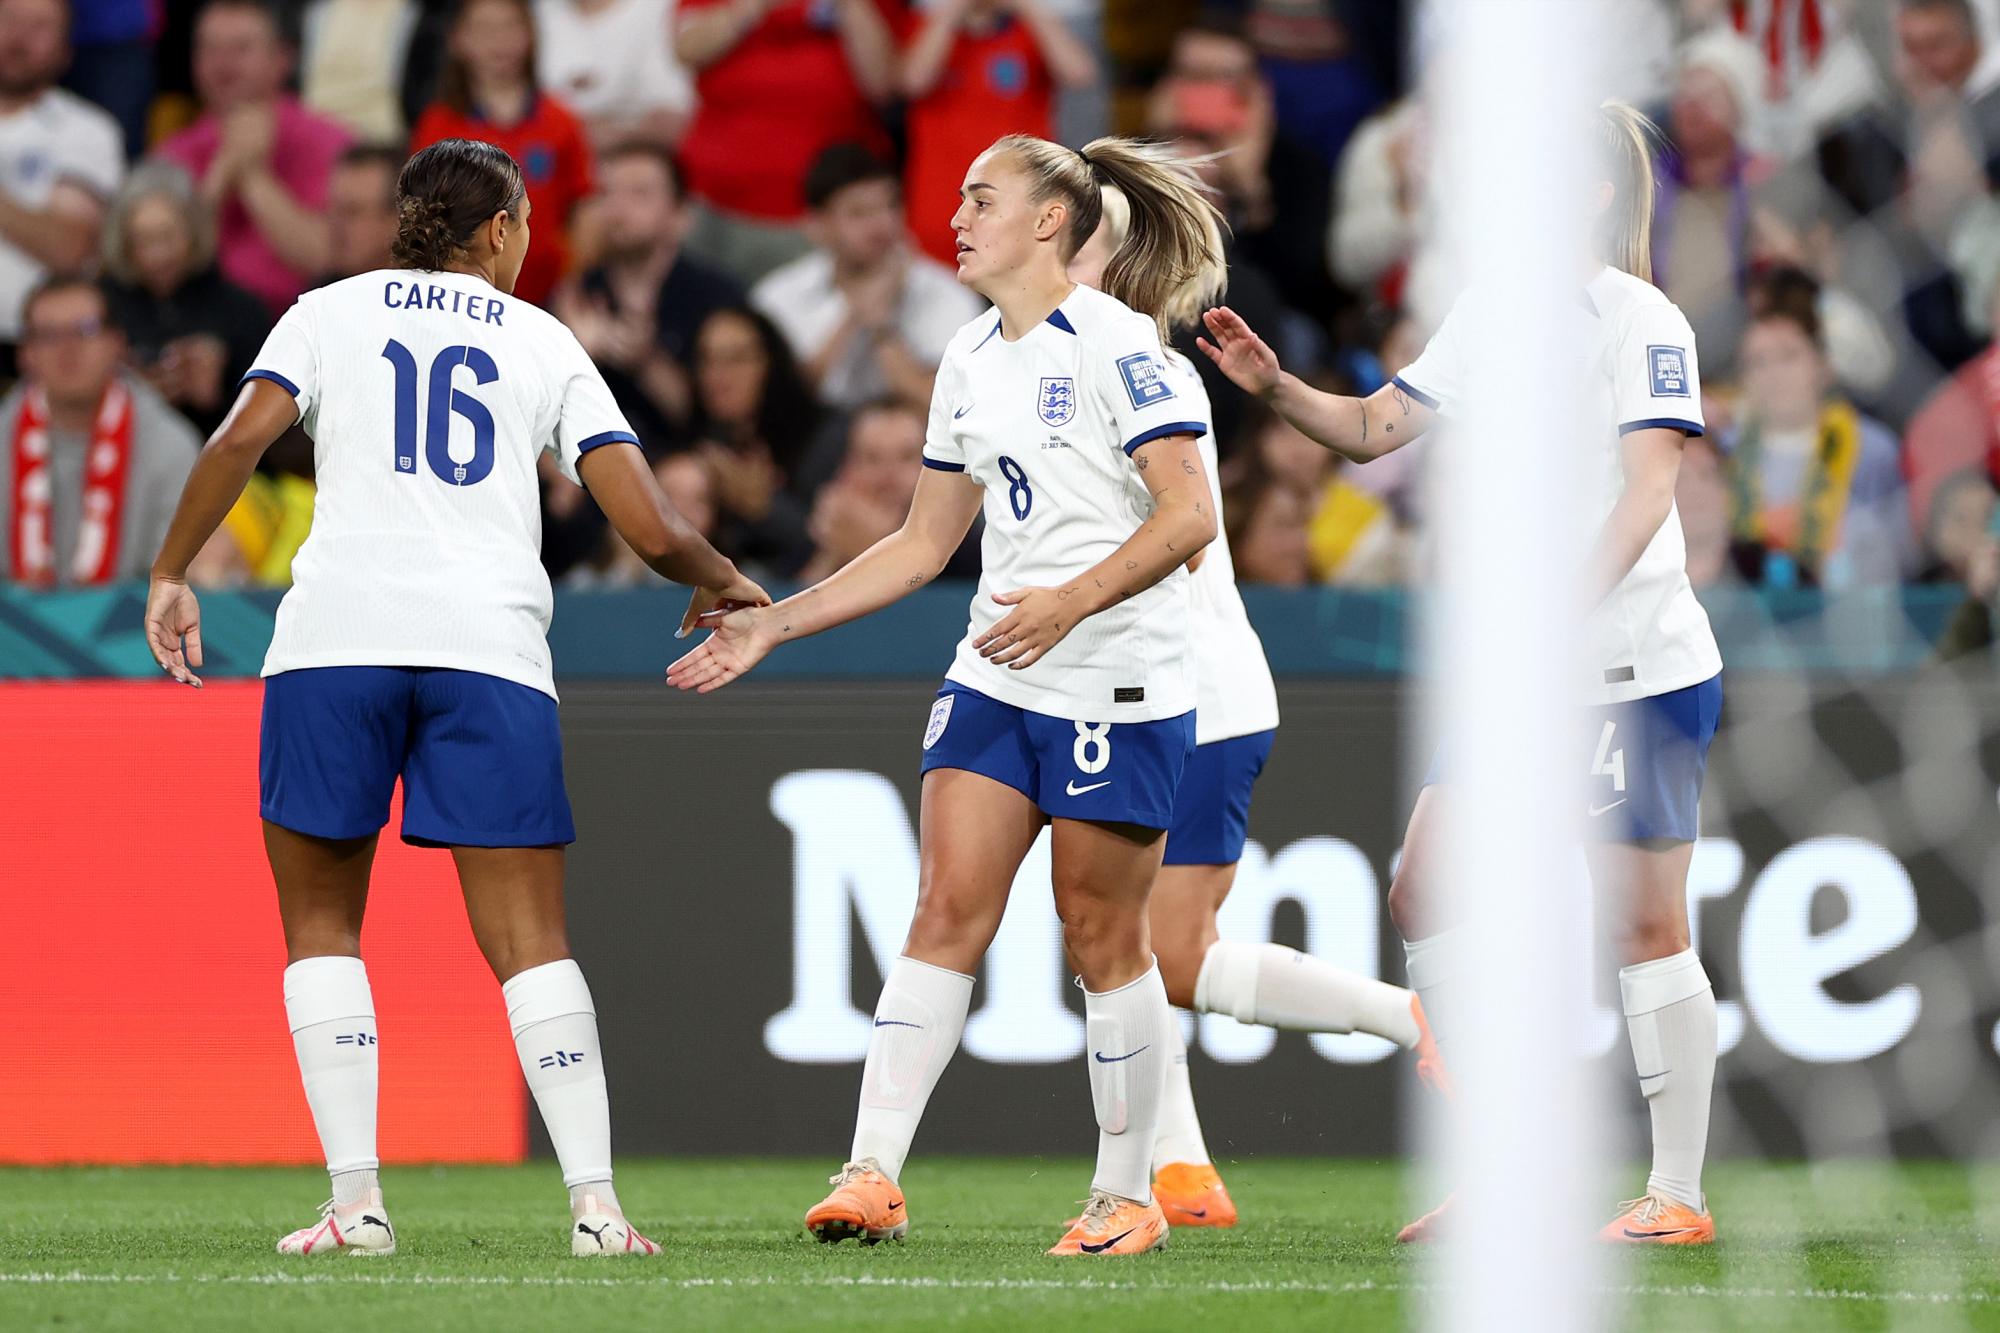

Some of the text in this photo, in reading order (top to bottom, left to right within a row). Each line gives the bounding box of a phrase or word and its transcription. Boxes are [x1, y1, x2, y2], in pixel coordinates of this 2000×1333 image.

[384, 281, 504, 327] CARTER
[1129, 359, 1153, 372] FOOTBAL
[381, 338, 499, 487] 16
[998, 455, 1032, 521] 8
[1074, 721, 1111, 774] 8
[1590, 720, 1625, 791] 4
